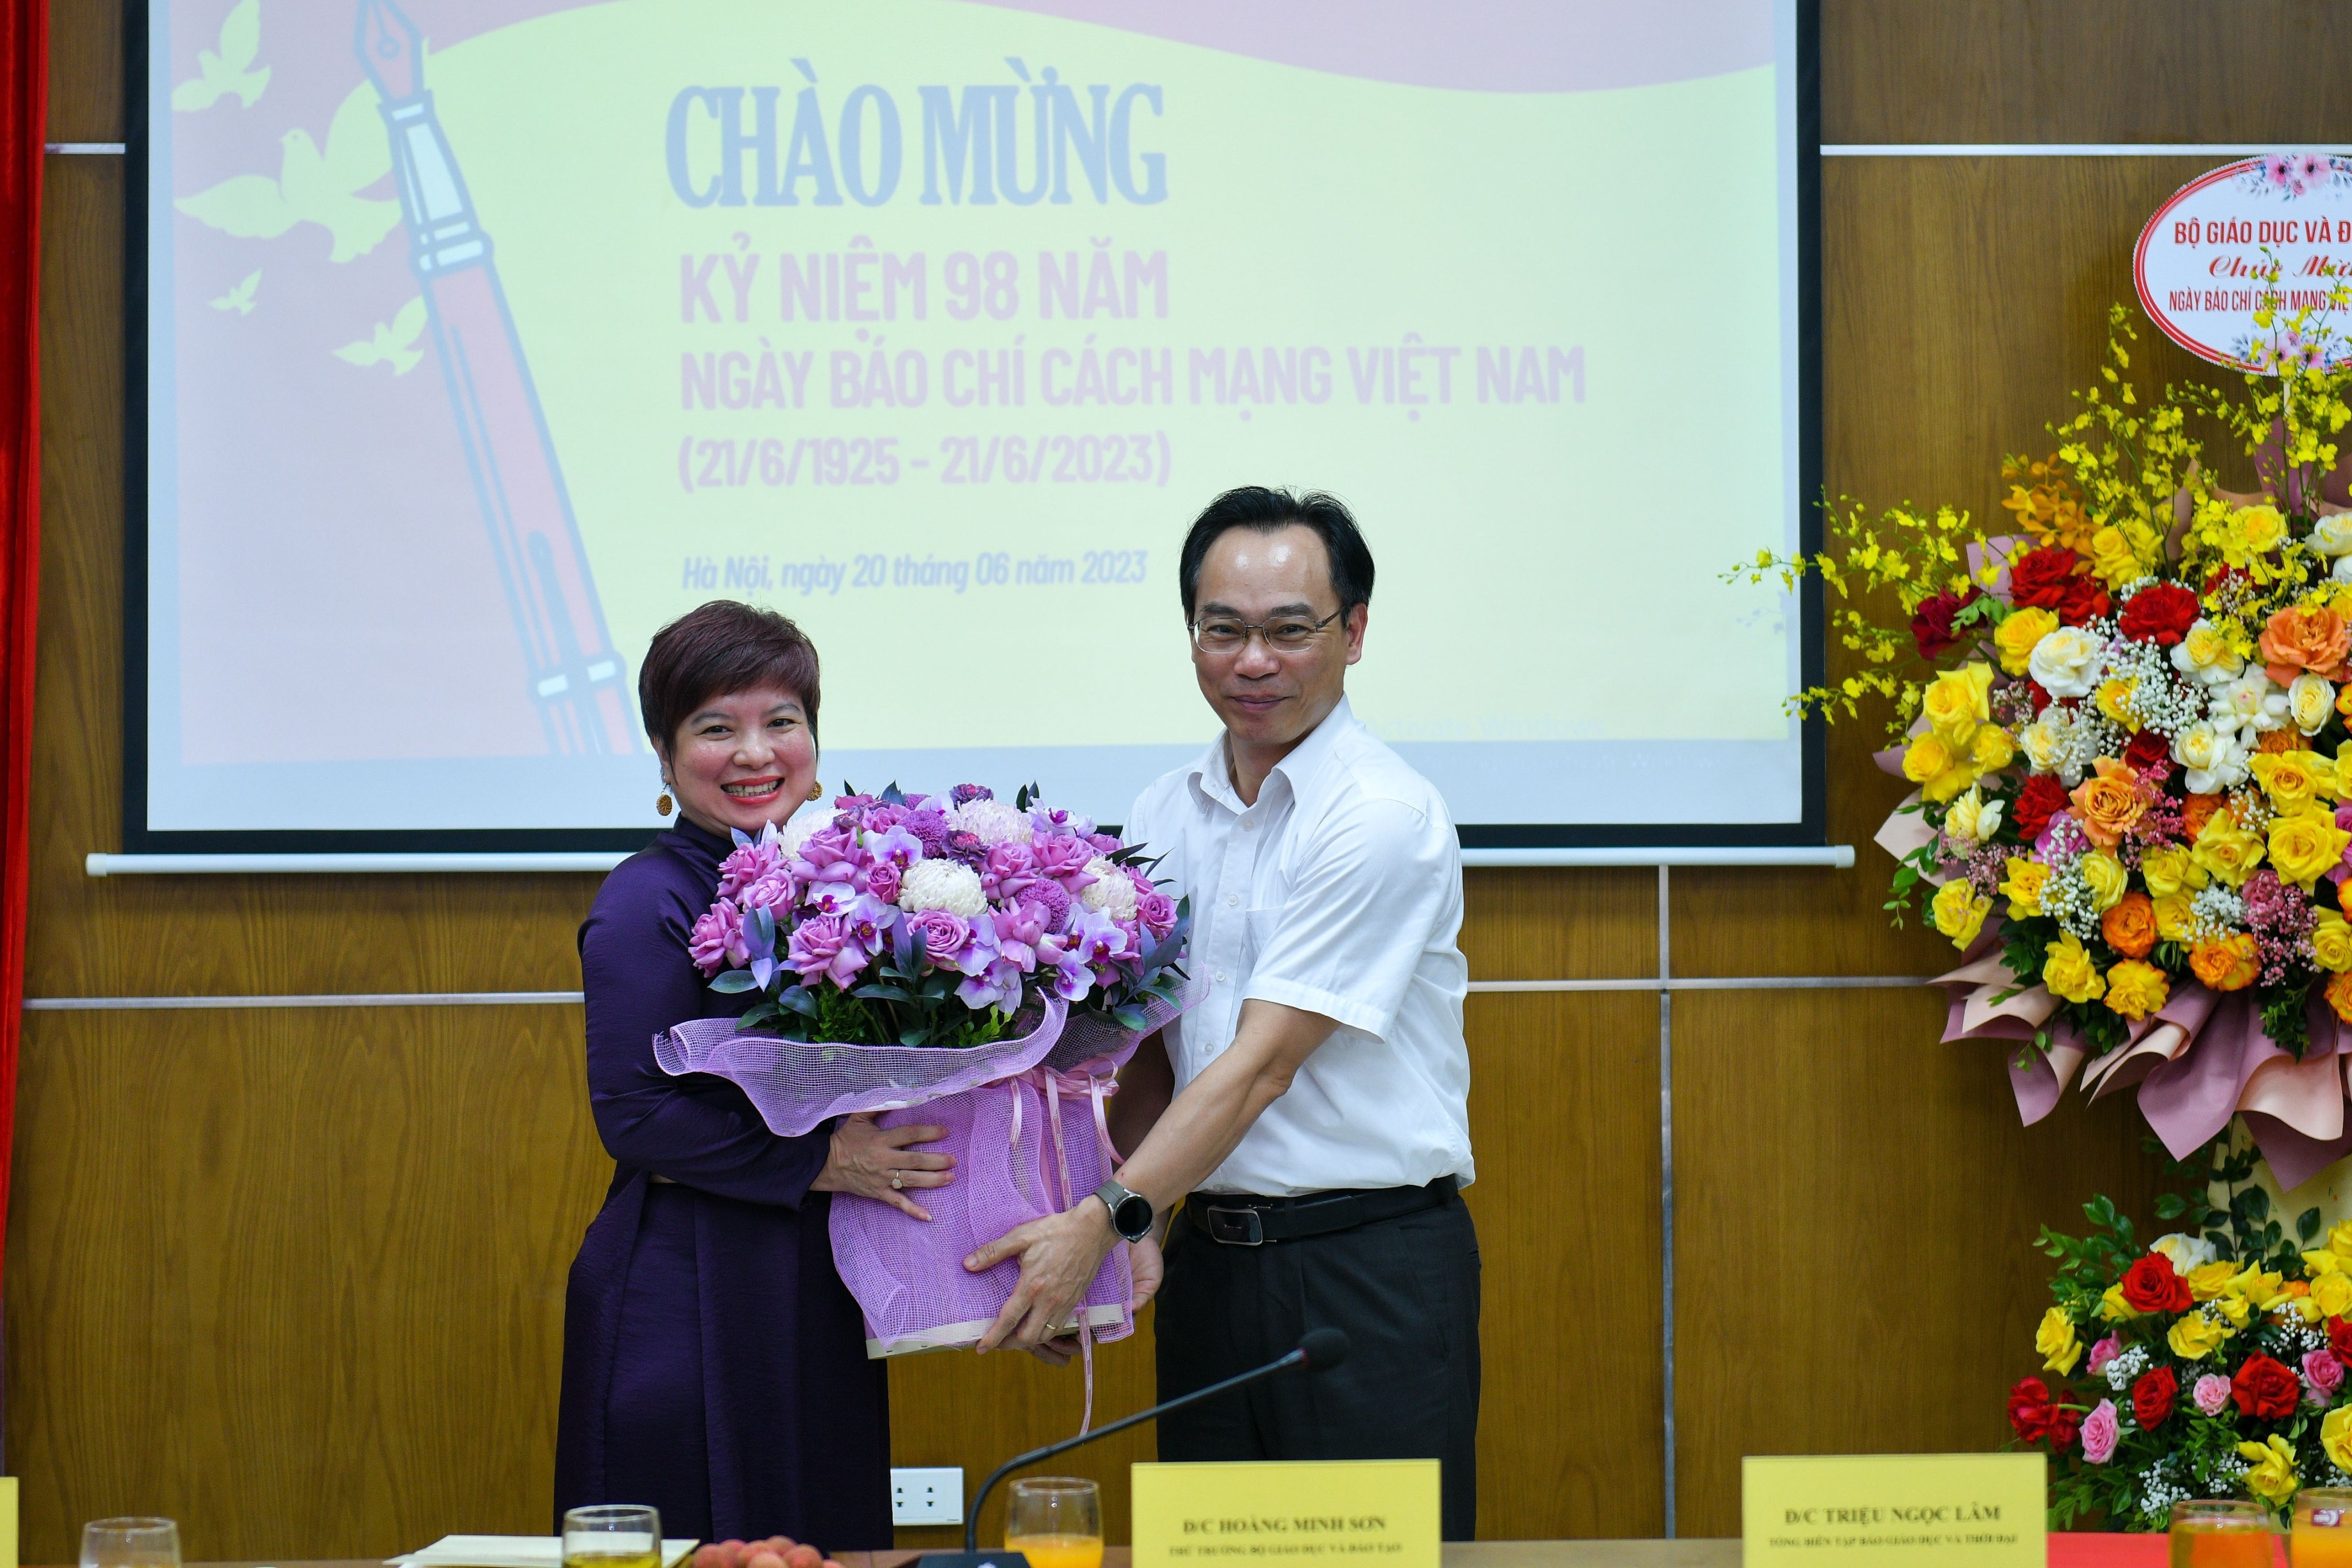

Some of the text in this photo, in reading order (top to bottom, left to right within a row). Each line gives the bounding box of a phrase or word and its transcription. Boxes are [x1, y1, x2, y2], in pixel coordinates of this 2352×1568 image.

[666, 57, 1169, 208] CHÀO MỪNG
[2175, 216, 2200, 249] BỘ
[2206, 216, 2252, 244] GIÁO
[2258, 220, 2298, 248] DỤC
[2304, 215, 2331, 243] VÀ
[681, 231, 1168, 343] KỶ NIỆM 98 NĂM
[2169, 285, 2201, 311] NGÀY
[2205, 285, 2228, 311] BÁO
[2232, 285, 2251, 311] CHÍ
[682, 332, 1585, 422] NGÀY BÁO CHÍ CÁCH MẠNG VIỆT NAM
[679, 437, 900, 493] (21/6/1925
[940, 430, 1171, 487] 21/6/2023)
[683, 550, 1148, 596] Hà Nội, ngày 20 tháng 06 năm 2023
[1293, 1516, 1344, 1533] MINH
